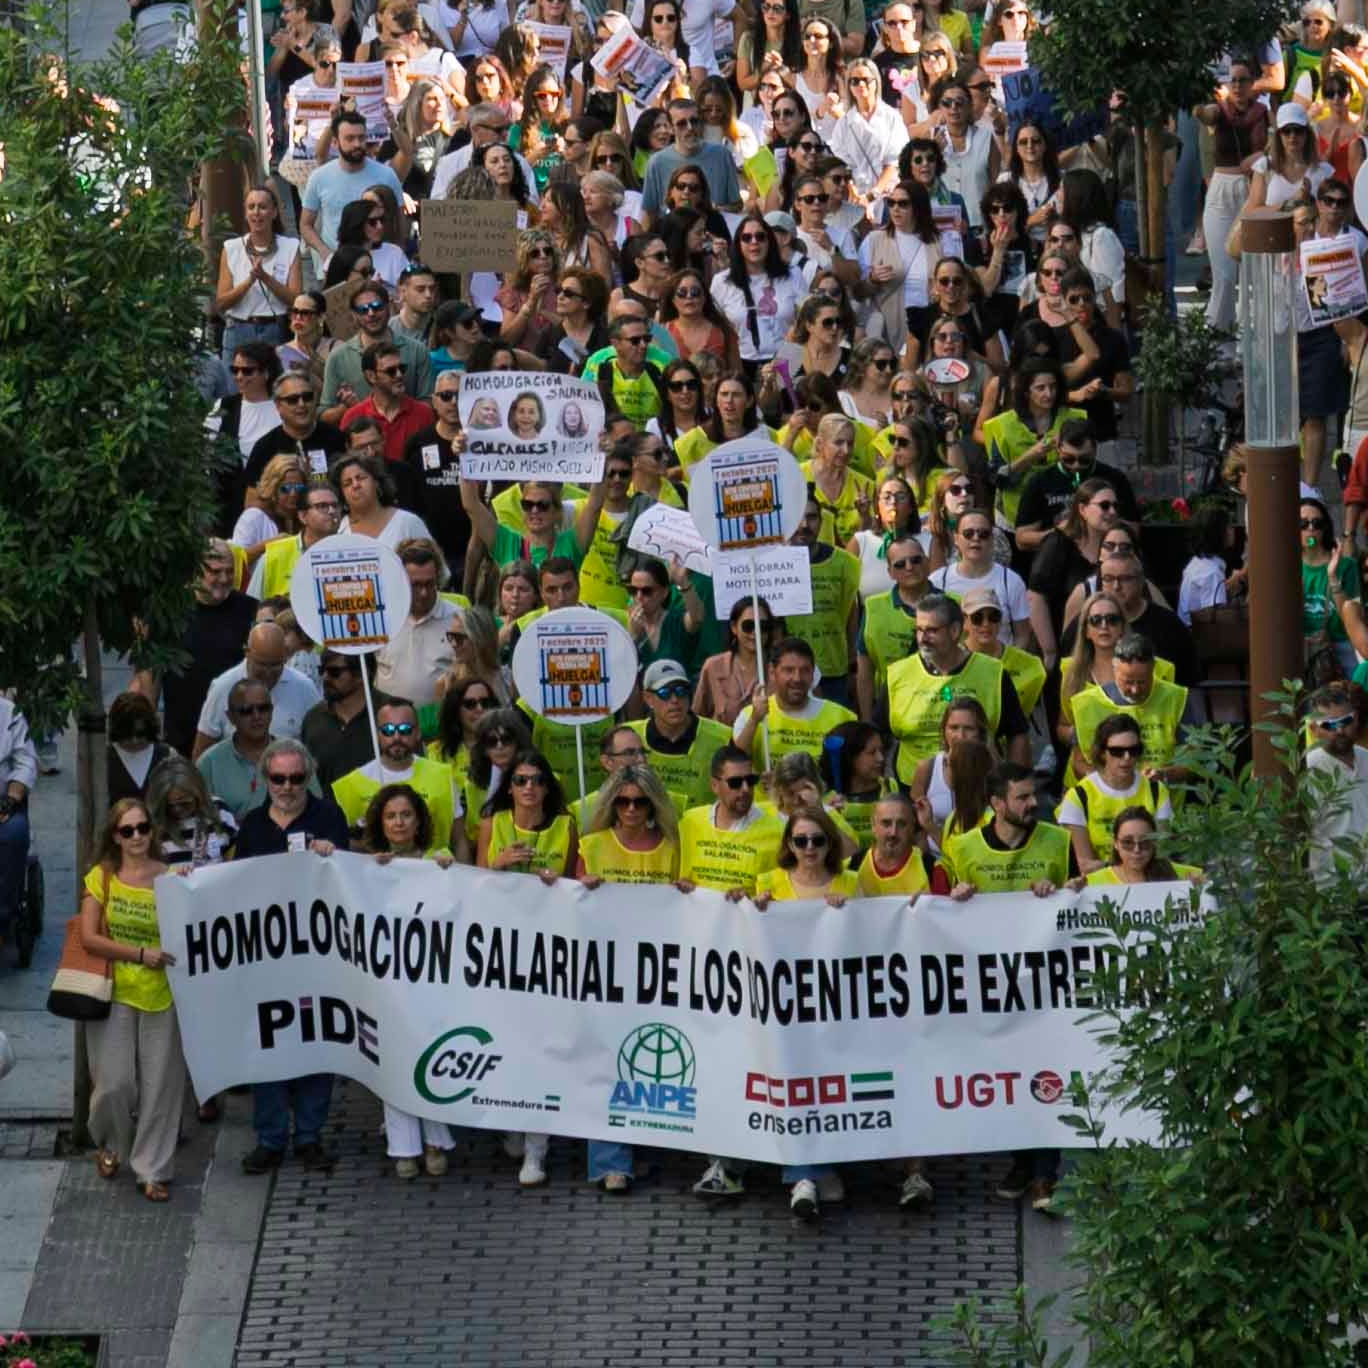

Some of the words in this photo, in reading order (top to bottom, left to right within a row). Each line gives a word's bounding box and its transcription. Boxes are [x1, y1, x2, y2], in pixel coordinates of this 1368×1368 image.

[185, 898, 454, 984] HOMOLOGACIÓN
[463, 922, 625, 1004] SALARIAL
[637, 942, 681, 1007] DE
[689, 946, 743, 1016] LOS
[920, 953, 969, 1016] DE
[431, 1048, 504, 1082] CSIF
[471, 1095, 544, 1112] Extremadura
[608, 1078, 698, 1114] ANPE
[935, 1072, 1022, 1110] UGT
[629, 1118, 695, 1134] EXTREMADURA
[748, 1108, 894, 1136] enseñanza
